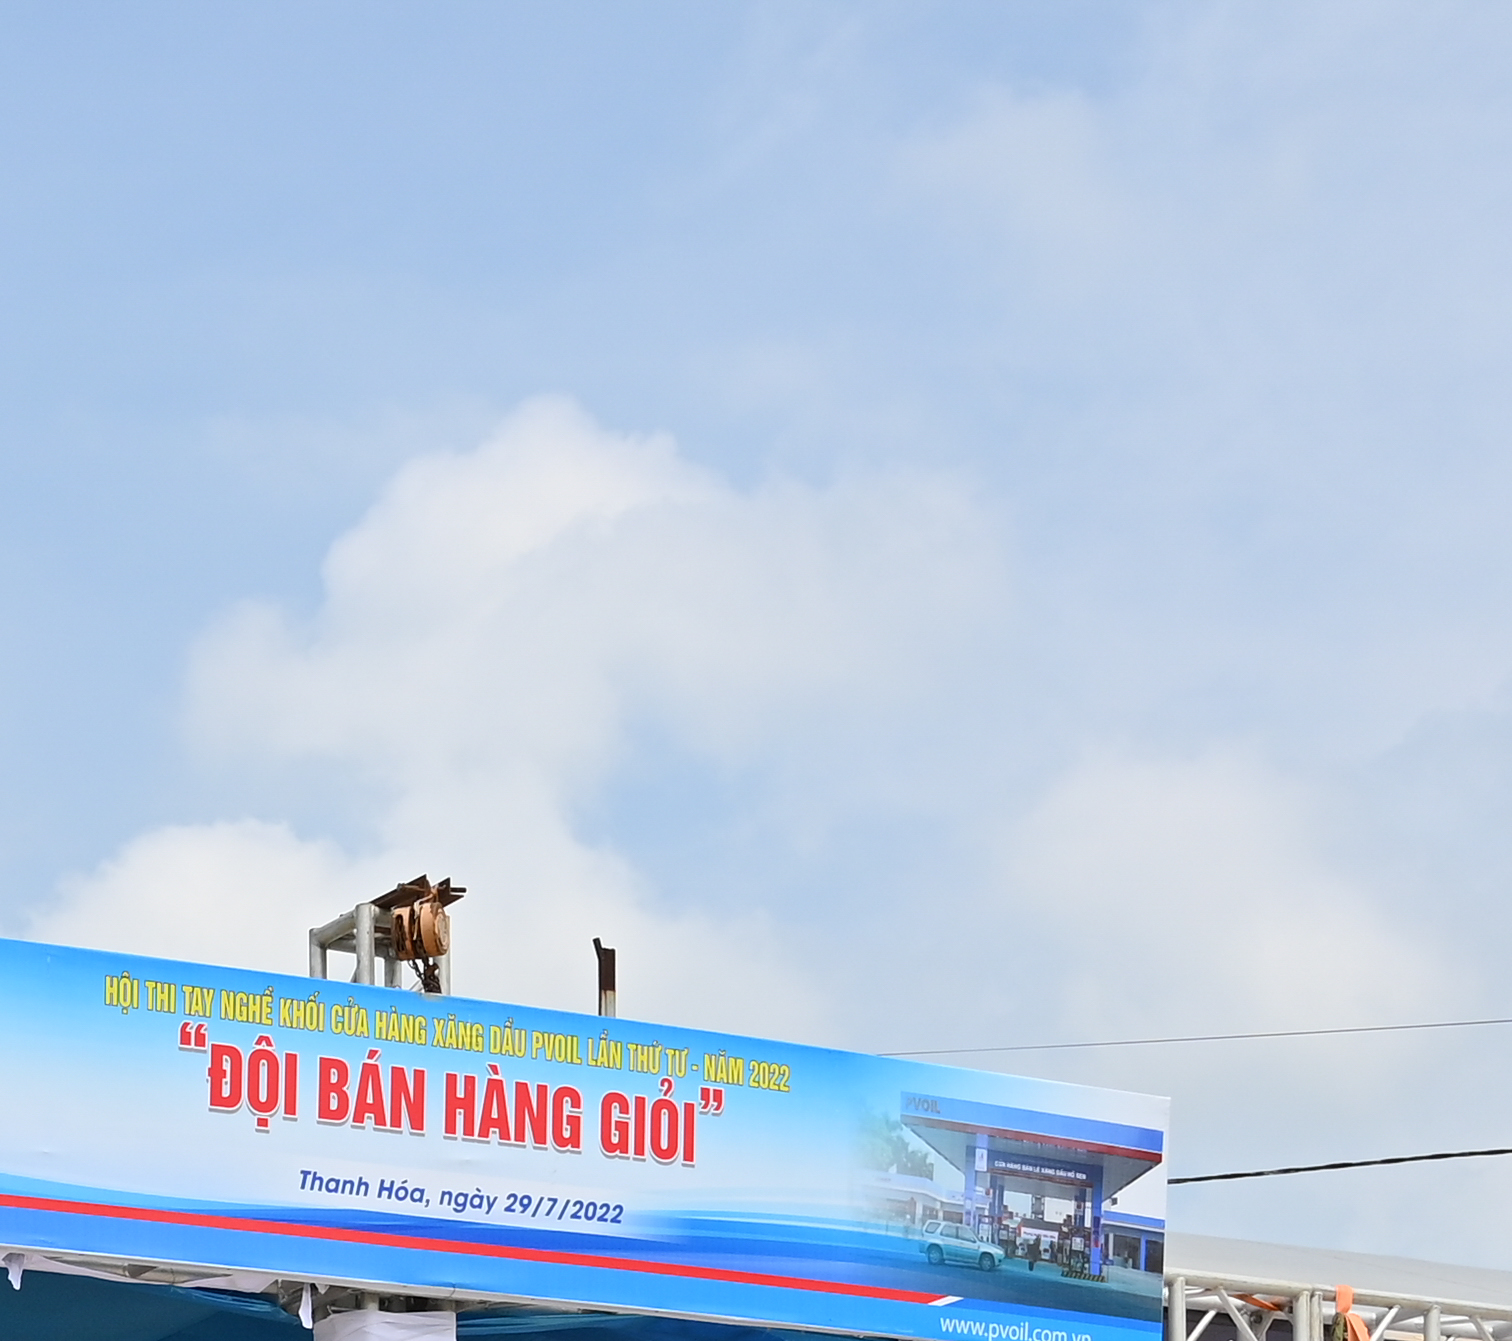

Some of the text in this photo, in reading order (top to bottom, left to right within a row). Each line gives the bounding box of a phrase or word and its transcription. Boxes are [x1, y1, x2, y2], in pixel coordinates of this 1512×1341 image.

[104, 971, 140, 1015] HỘI
[144, 980, 177, 1013] THI
[180, 984, 215, 1018] TAY
[220, 985, 275, 1027] NGHỀ
[279, 990, 325, 1032] KHỐI
[330, 996, 370, 1039] CỬA
[374, 1005, 427, 1047] HÀNG
[432, 1013, 486, 1053] XĂNG
[531, 1030, 583, 1066] PVOIL
[627, 1040, 662, 1076] THỨ
[665, 1047, 689, 1078] TƯ
[703, 1049, 745, 1086] NĂM
[748, 1060, 791, 1092] 2022
[317, 1049, 426, 1136] BÁN
[443, 1063, 584, 1153] HÀNG
[299, 1170, 624, 1225] Thanh Hóa, ngày 29/7/2022
